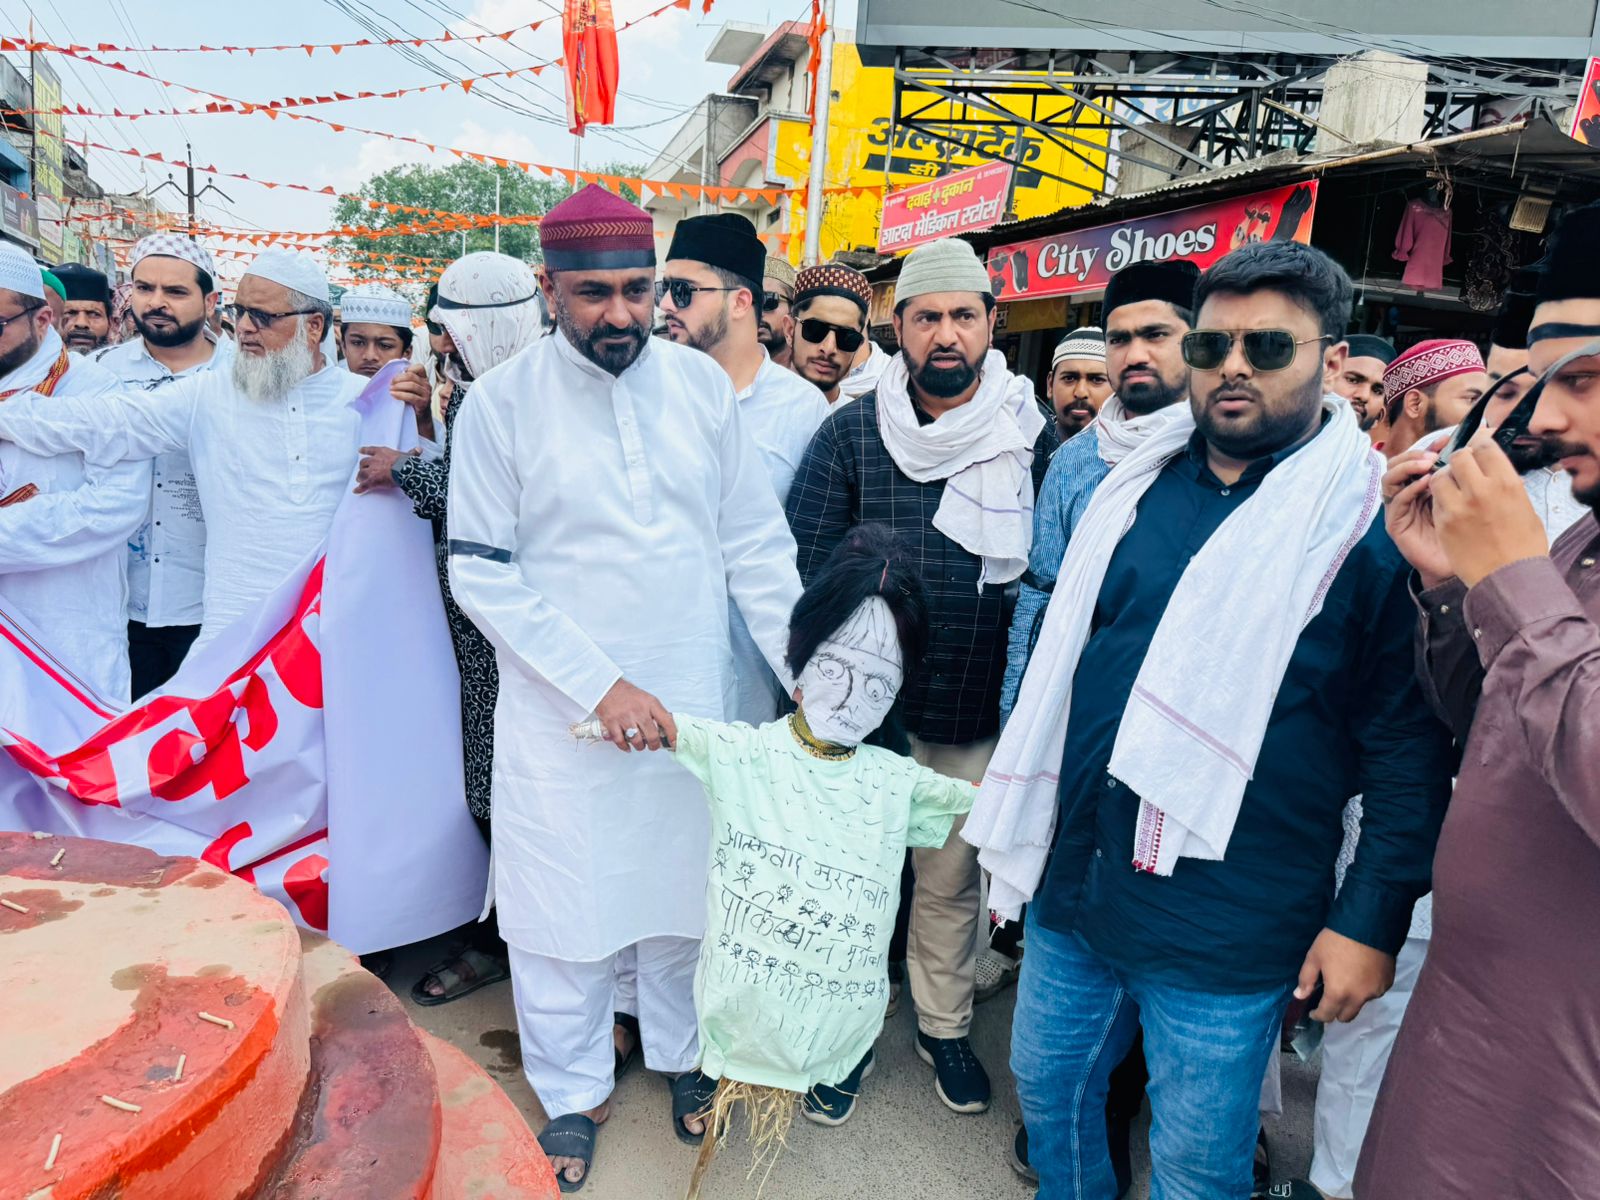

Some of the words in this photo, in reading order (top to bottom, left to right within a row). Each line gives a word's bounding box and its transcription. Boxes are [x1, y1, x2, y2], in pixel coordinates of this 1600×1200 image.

[906, 184, 934, 211] दवाई
[940, 176, 975, 206] दुकान
[914, 209, 961, 236] मेडिकल
[1037, 243, 1100, 281] City
[1105, 223, 1218, 272] Shoes
